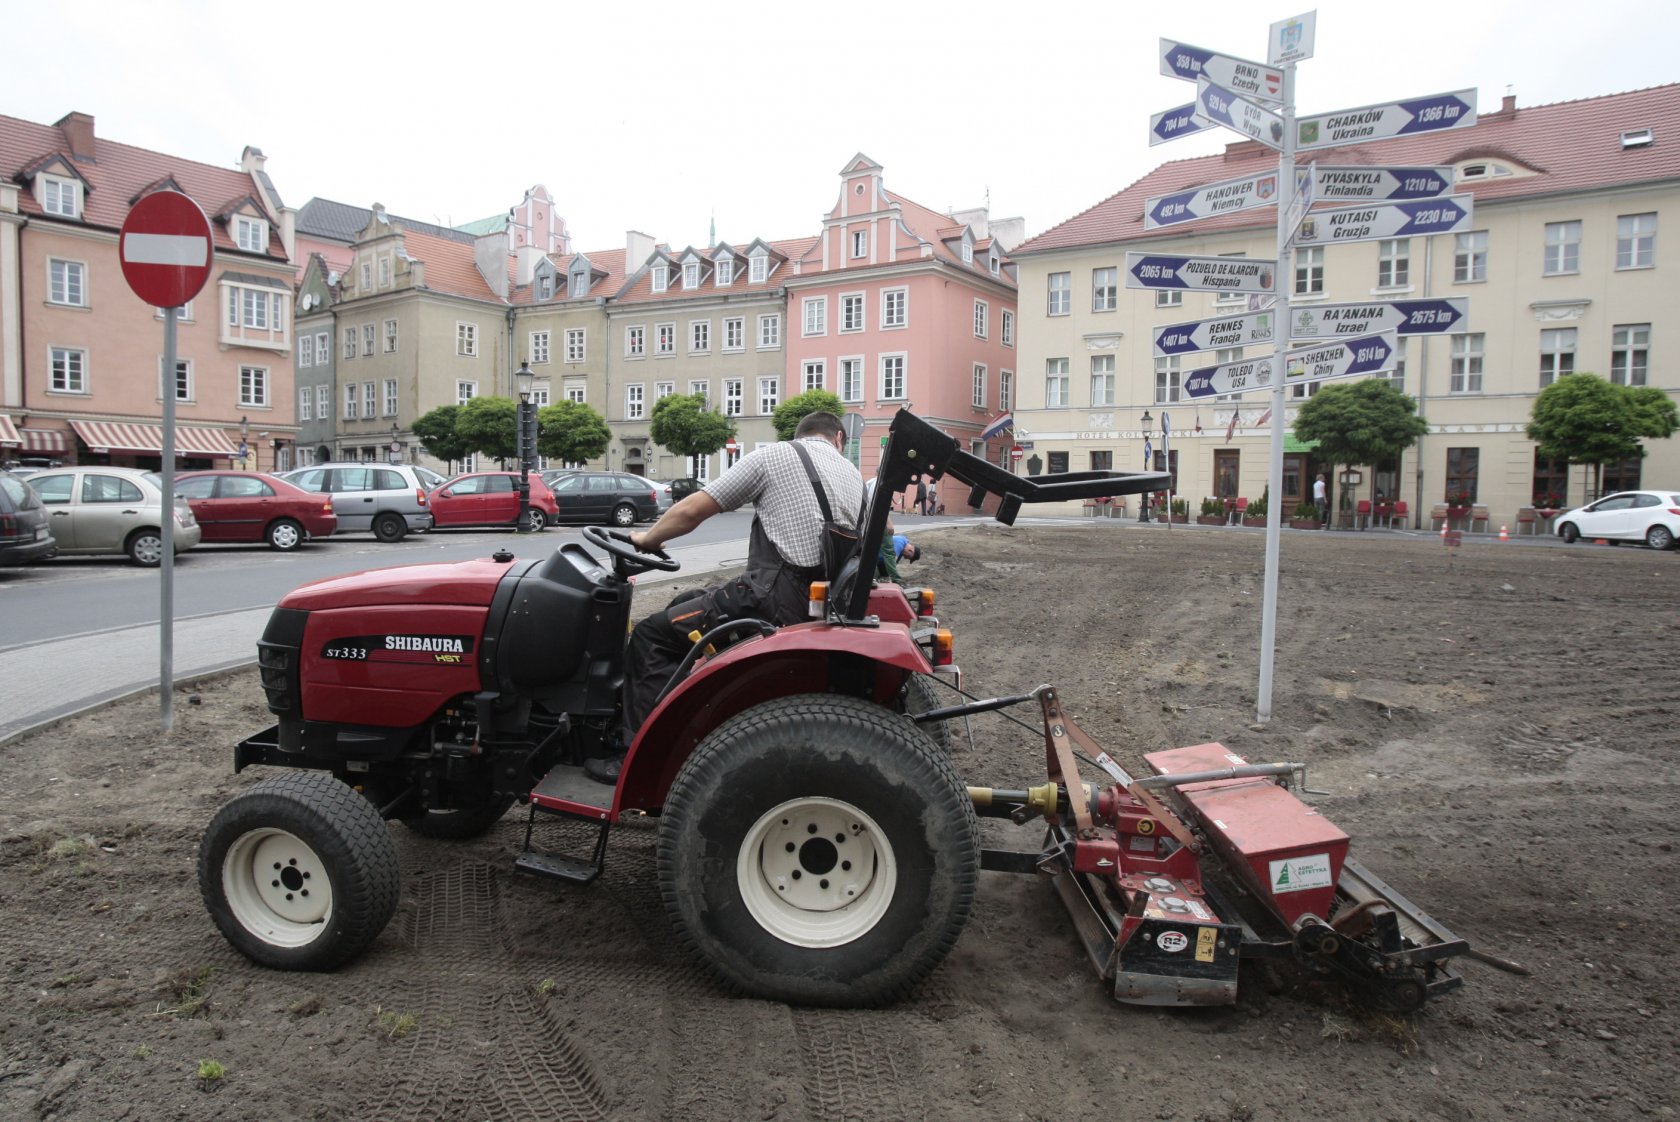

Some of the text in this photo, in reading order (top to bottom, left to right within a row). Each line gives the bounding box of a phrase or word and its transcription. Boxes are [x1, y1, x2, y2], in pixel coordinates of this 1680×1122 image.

[1176, 54, 1202, 72] 358 km
[1235, 64, 1259, 79] BRNO
[1232, 75, 1260, 93] Czechy
[1164, 115, 1189, 133] 704 km
[1326, 104, 1460, 130] CHARKÓW 1366 km
[1332, 125, 1375, 141] Ukraina
[1205, 181, 1254, 202] HANOWER
[1324, 185, 1374, 196] Finlandia
[1404, 179, 1425, 191] 1210
[1425, 178, 1440, 191] km
[1160, 202, 1185, 218] 492 km
[1211, 196, 1246, 212] Niemcy
[1329, 210, 1457, 225] KUTAISI 2230 km
[1333, 226, 1370, 239] Gruzja
[1139, 262, 1260, 279] 2065 km POZUELO DE ALARCÓN
[1202, 275, 1241, 288] Hiszpania
[1322, 307, 1452, 325] RA'ANANA 2675 km
[1209, 319, 1244, 334] RENNES
[1335, 321, 1369, 333] Izrael
[1178, 333, 1188, 345] km
[1209, 332, 1241, 345] Francja
[1305, 345, 1386, 365] SHENZHEN 8514 km
[1227, 364, 1254, 378] TOLEDO
[1313, 364, 1334, 376] Chiny
[1201, 377, 1209, 388] km
[1231, 377, 1246, 389] USA
[385, 635, 464, 653] SHIBAURA
[326, 647, 367, 659] ST333
[434, 654, 461, 662] HST
